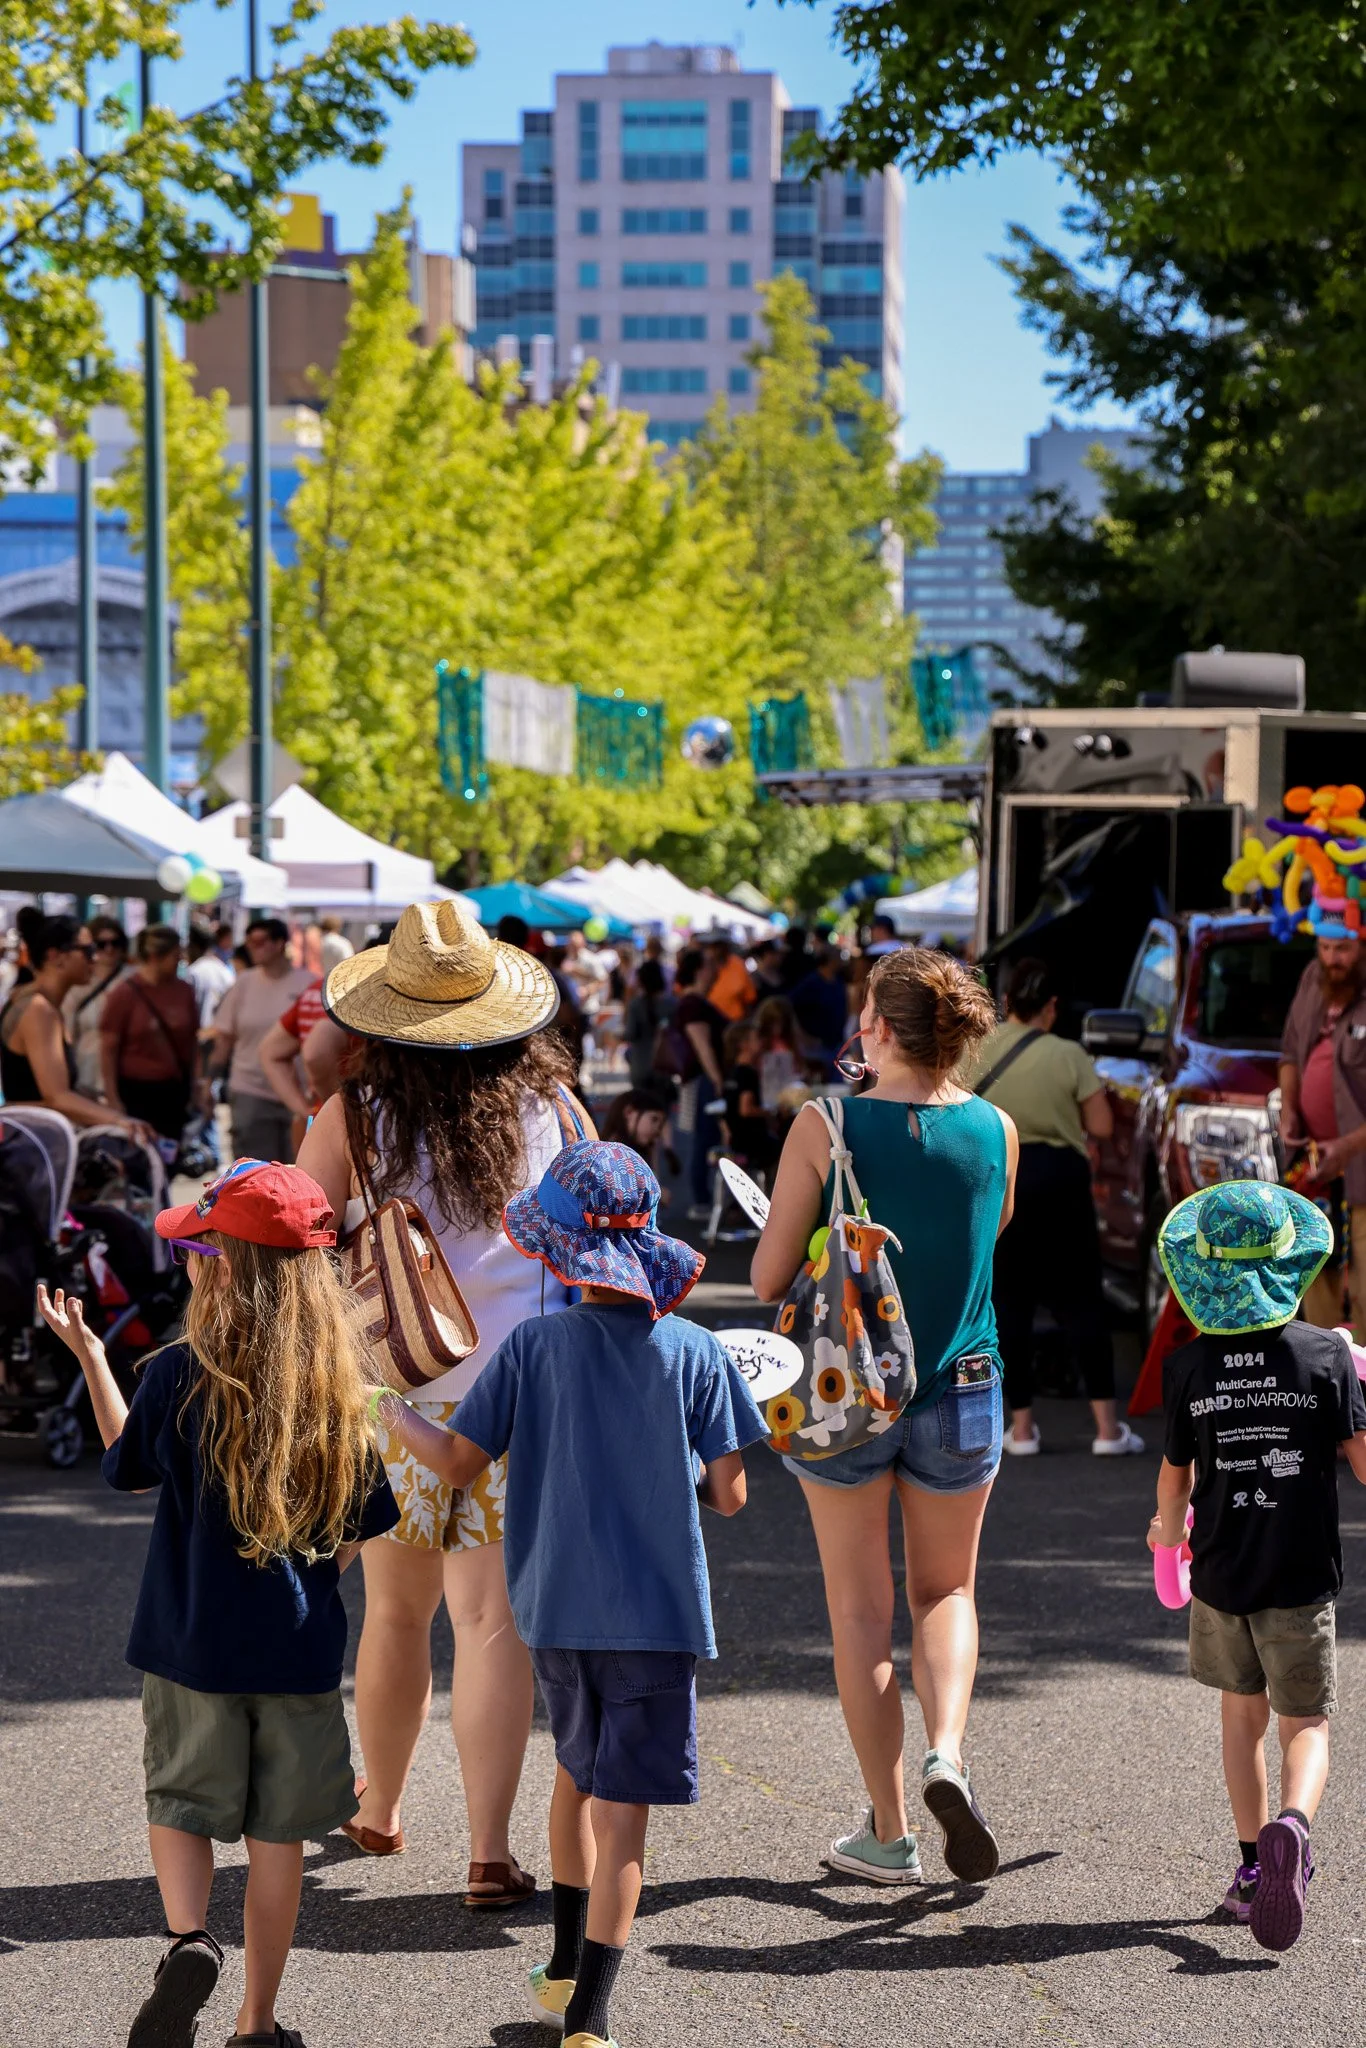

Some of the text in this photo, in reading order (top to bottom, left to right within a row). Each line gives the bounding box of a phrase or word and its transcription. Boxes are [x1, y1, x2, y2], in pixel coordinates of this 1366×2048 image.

[1223, 1352, 1265, 1369] 2024
[1216, 1378, 1263, 1391] MultiCare
[1190, 1392, 1318, 1417] SOUND to NARROWS
[1216, 1428, 1238, 1437] esented
[1222, 1435, 1241, 1443] Health
[1241, 1433, 1258, 1441] Equity
[1261, 1448, 1305, 1468] Wilcox
